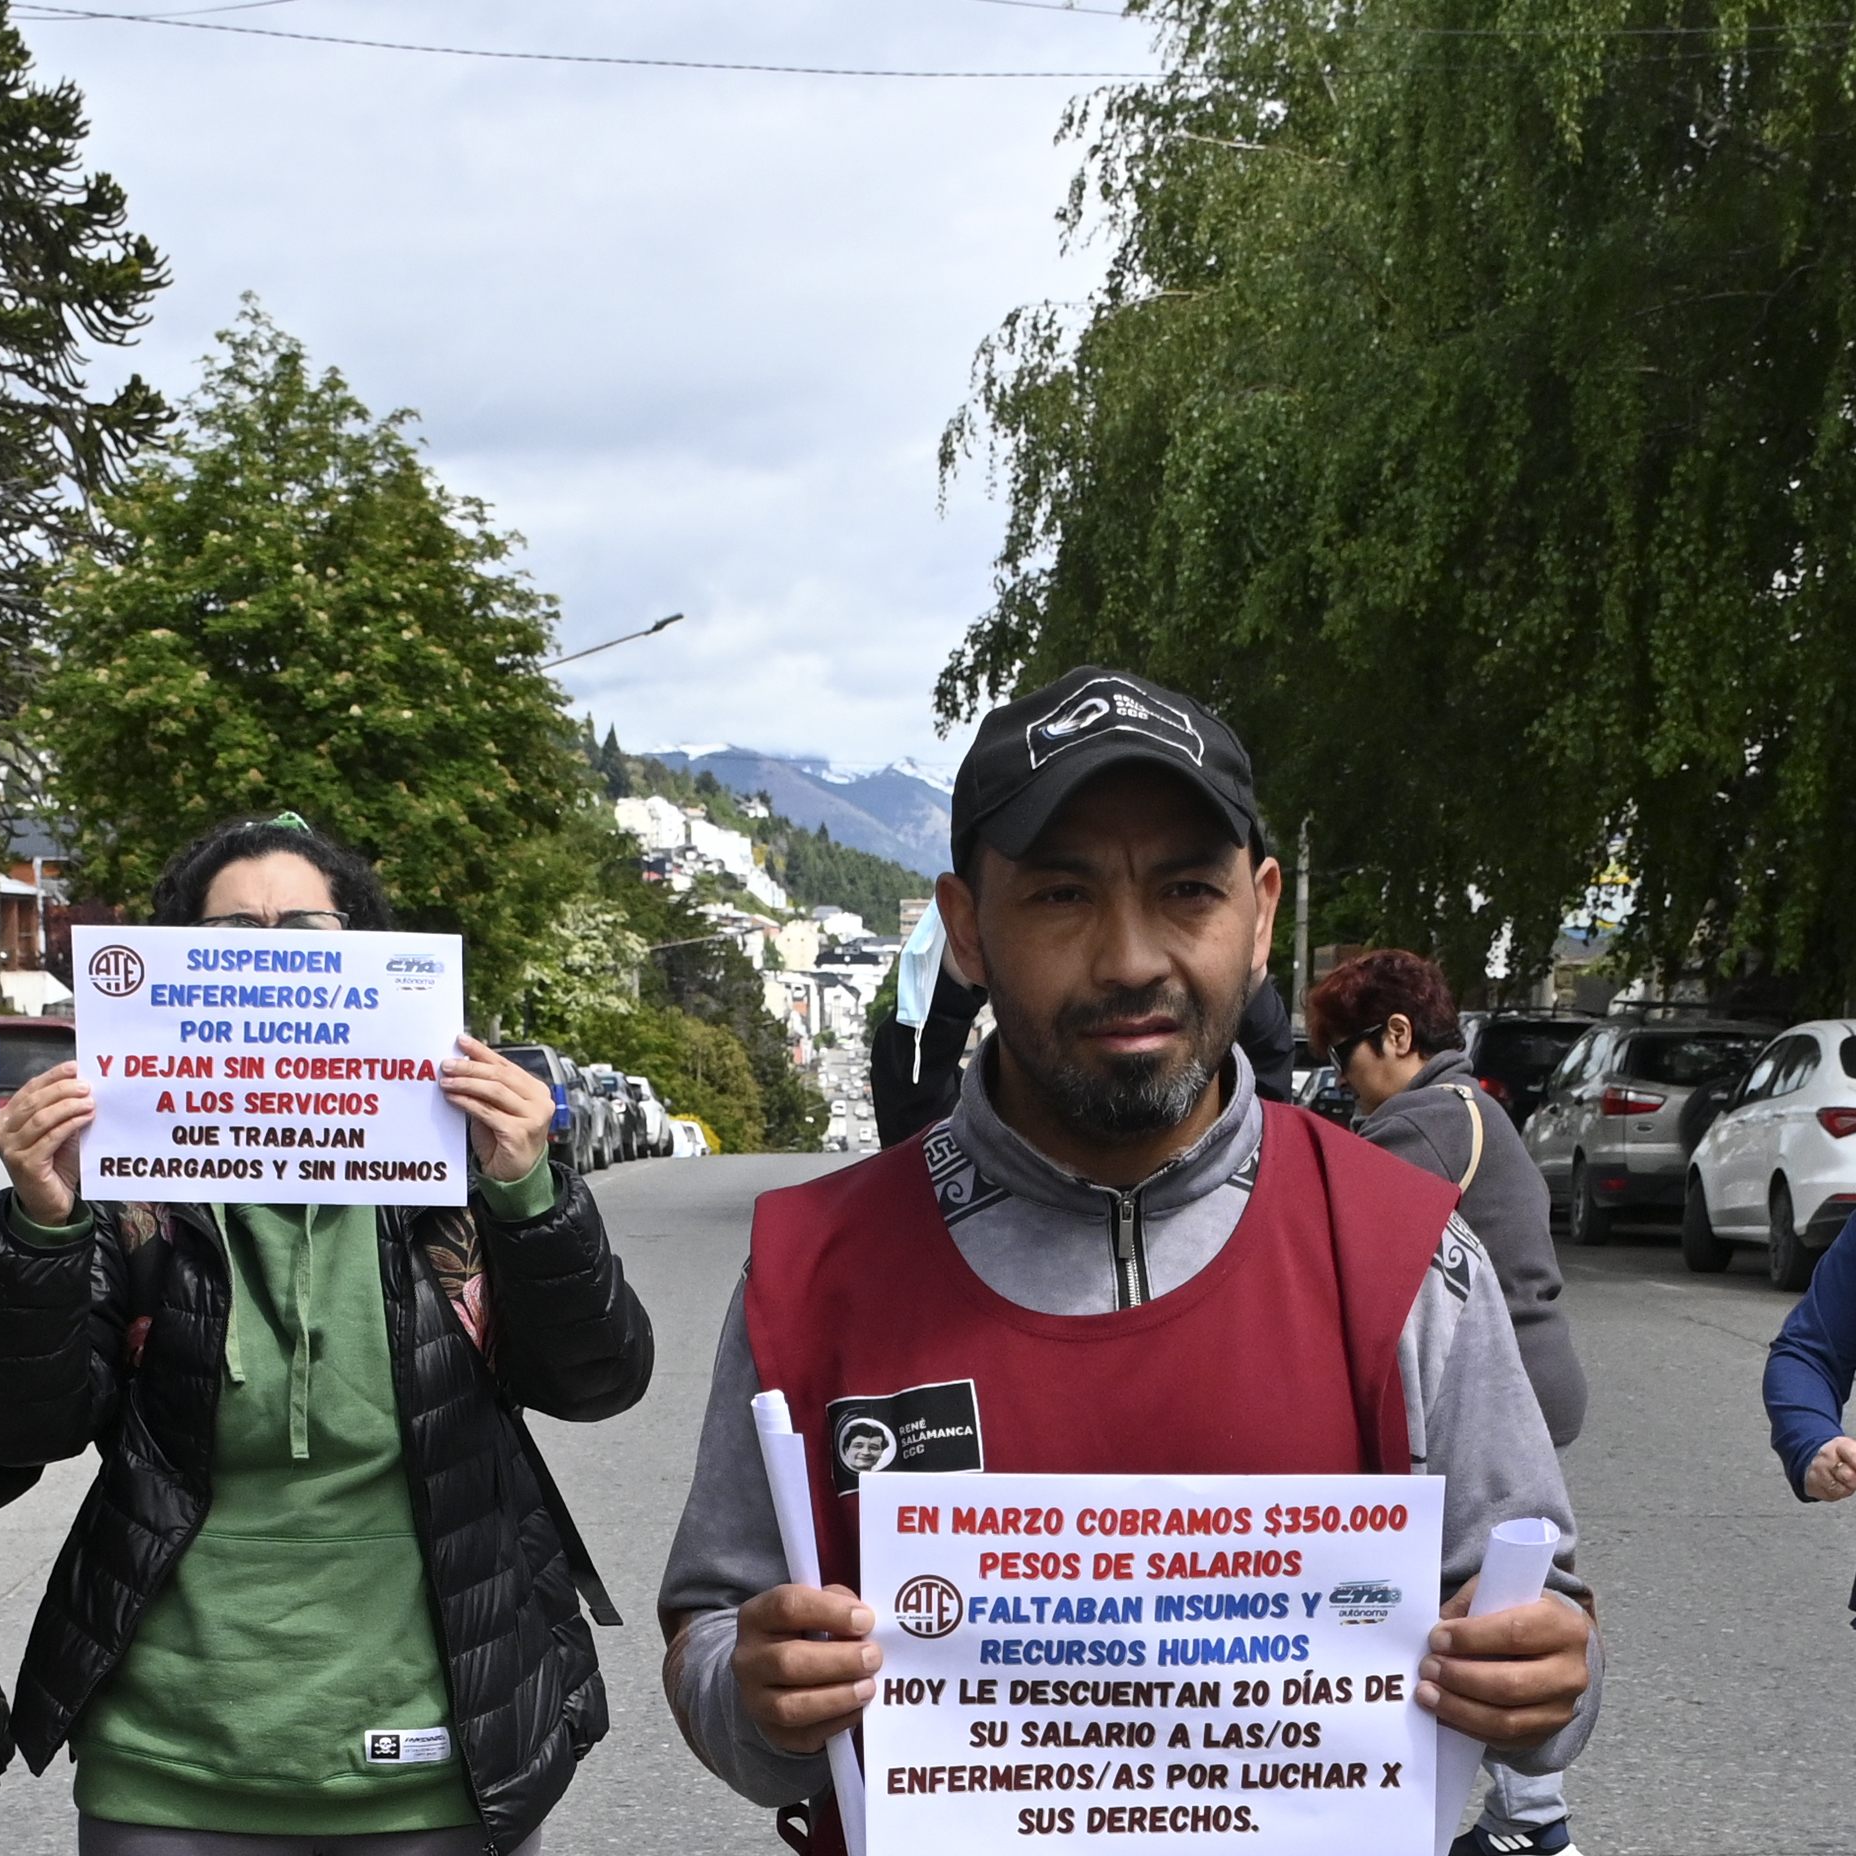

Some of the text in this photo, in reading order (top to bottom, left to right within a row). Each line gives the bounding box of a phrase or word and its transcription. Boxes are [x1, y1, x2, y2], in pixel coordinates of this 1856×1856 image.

[187, 949, 341, 973] SUSPENDEN
[151, 984, 378, 1009] ENFERMEROS/AS
[181, 1020, 350, 1044] POR LUCHAR
[97, 1055, 436, 1081] Y DEJAN SIN COBERTURA
[156, 1091, 378, 1115] A LOS SERVICIOS
[172, 1125, 364, 1148] QUE TRABAJAN
[100, 1157, 447, 1181] RECARGADOS Y SIN INSUMOS
[899, 1417, 927, 1437] RENÉ
[901, 1425, 974, 1448] SALAMANCA
[902, 1444, 925, 1460] CCC
[897, 1503, 1408, 1537] EN MARZO COBRAMOS $350.000
[980, 1550, 1302, 1580] PESOS DE SALARIOS
[968, 1592, 1322, 1624] FALTABAN INSUMOS Y
[980, 1634, 1309, 1667] RECURSOS HUMANOS
[884, 1669, 1404, 1708] HOY LE DESCUENTAN 20 DÍAS DE
[969, 1720, 1321, 1749] SU SALARIO A LAS/OS
[888, 1761, 1402, 1794] ENFERMEROS/AS POR LUCHAR X
[1018, 1805, 1259, 1835] SUS DERECHOS.
